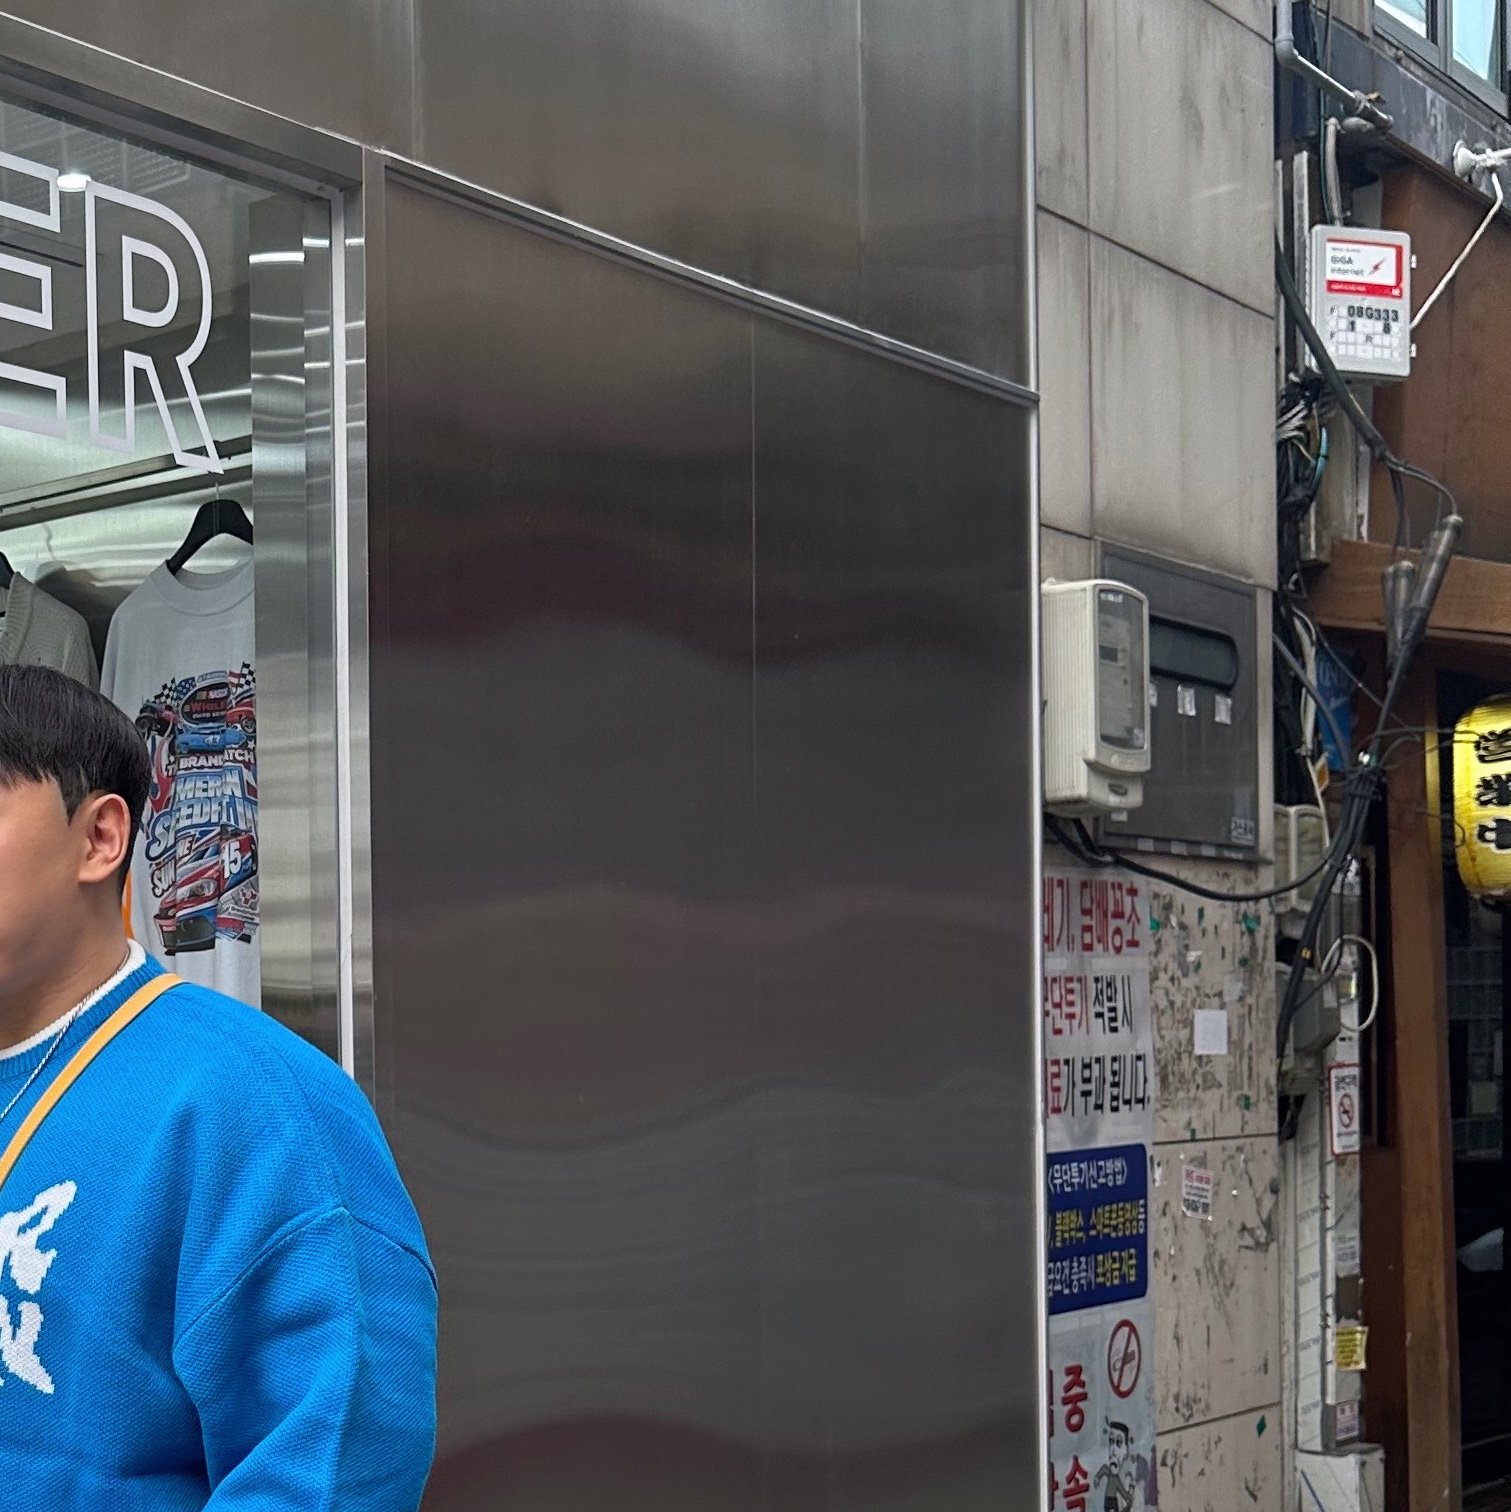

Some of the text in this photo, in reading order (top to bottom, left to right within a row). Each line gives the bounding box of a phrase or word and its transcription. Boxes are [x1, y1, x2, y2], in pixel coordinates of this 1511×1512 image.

[1080, 878, 1141, 955] 담배꽁초
[1044, 974, 1134, 1036] 단투기 적발 시
[1045, 1053, 1150, 1119] 료가 부과 됩니다.
[1049, 1364, 1088, 1437] 중
